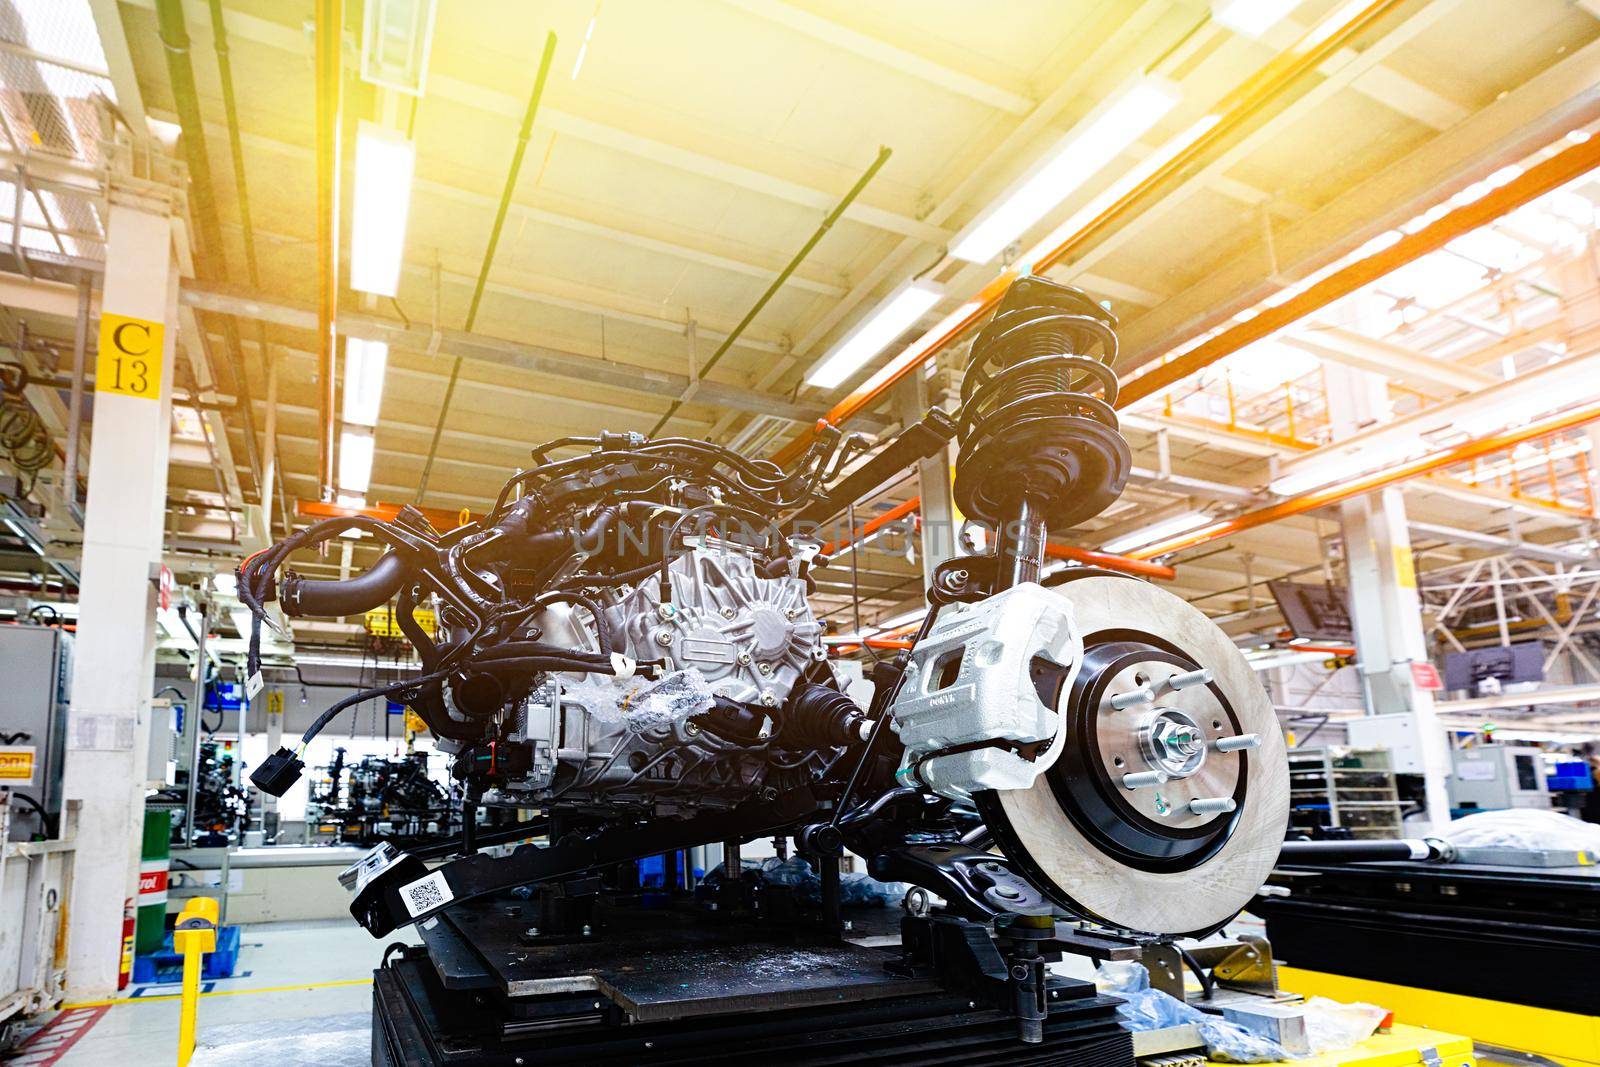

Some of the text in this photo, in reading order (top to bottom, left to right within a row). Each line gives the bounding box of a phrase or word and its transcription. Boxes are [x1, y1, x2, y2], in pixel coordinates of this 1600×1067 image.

[113, 322, 151, 356] C
[110, 358, 148, 393] 13
[139, 876, 157, 890] rol
